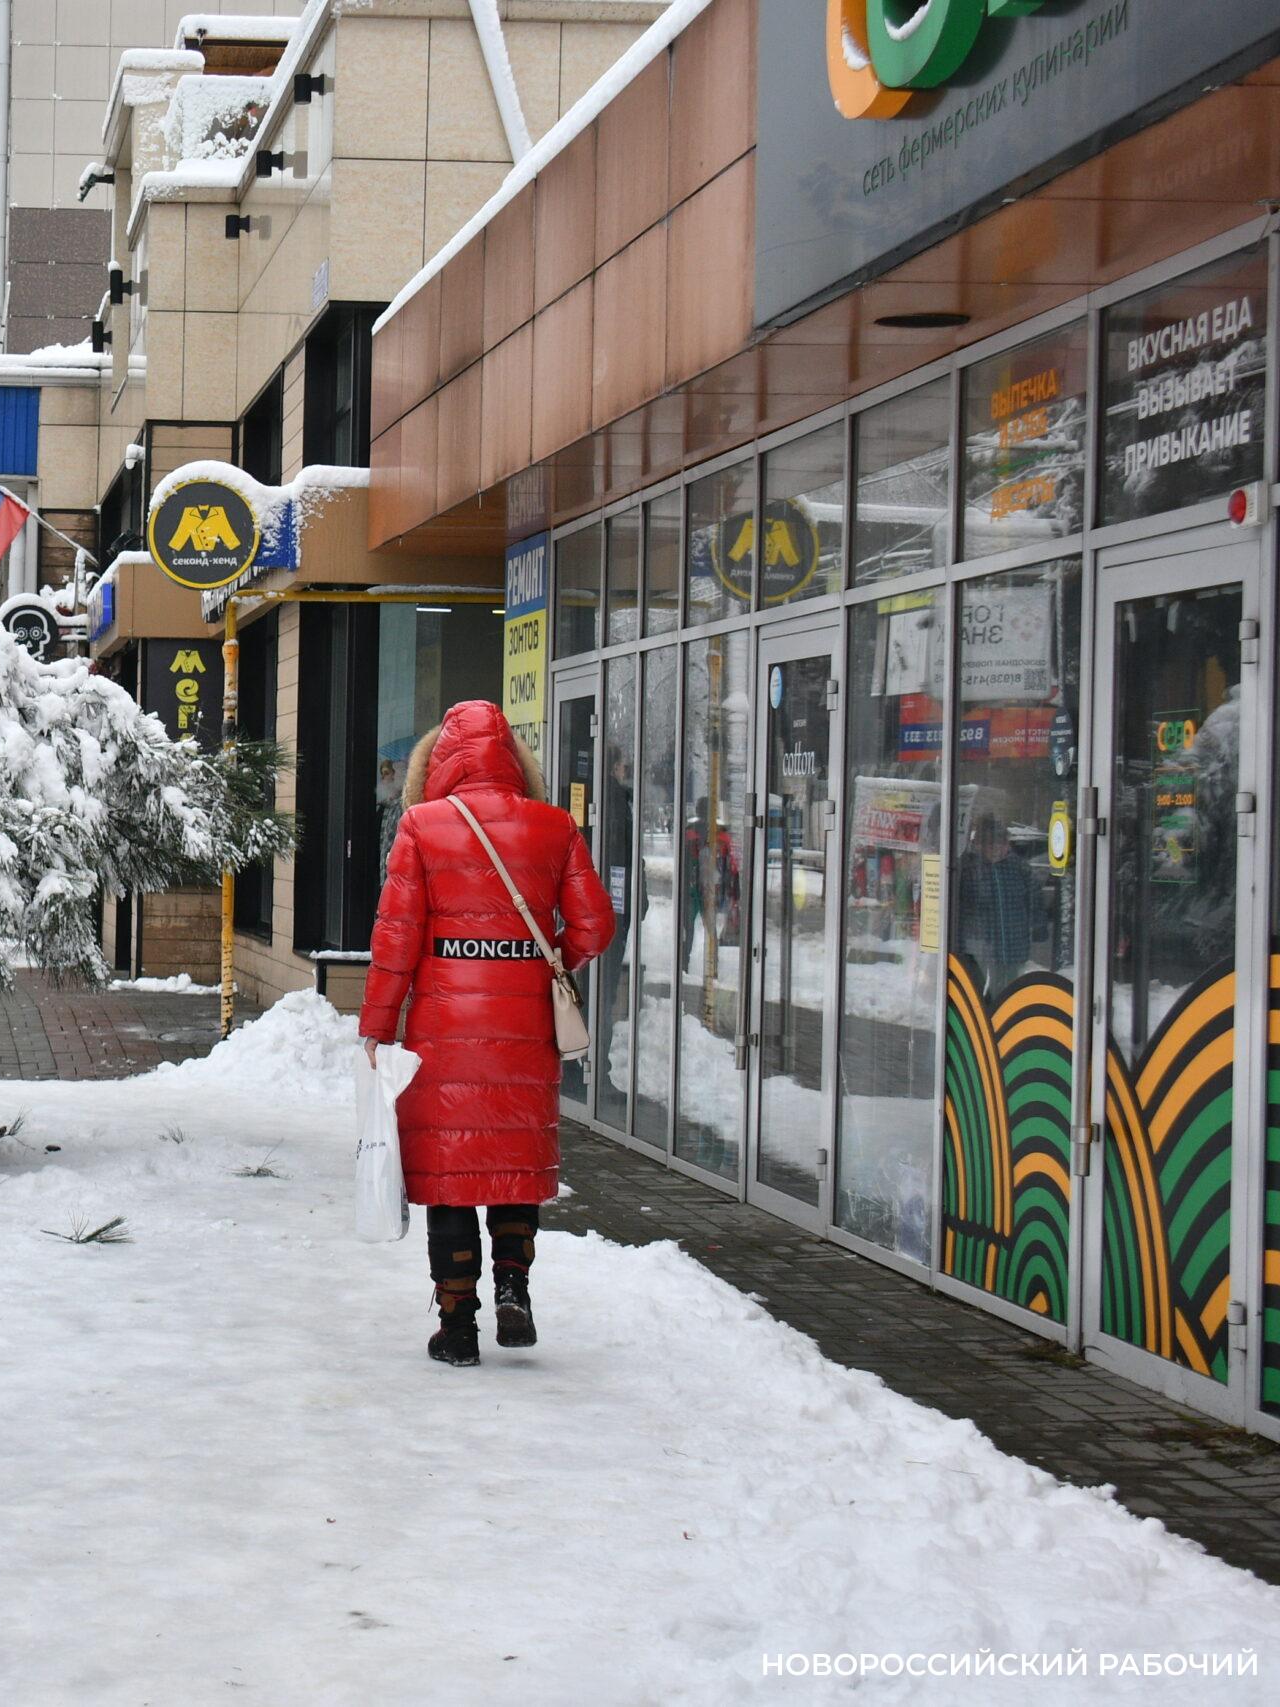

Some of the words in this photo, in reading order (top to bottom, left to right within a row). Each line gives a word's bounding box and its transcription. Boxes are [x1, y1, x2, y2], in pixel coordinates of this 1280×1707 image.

[862, 156, 895, 197] сеть
[898, 79, 1007, 181] фермерских
[1127, 311, 1209, 372] ВКУСНАЯ
[1212, 296, 1252, 344] ЕДА
[991, 368, 1058, 420] ВЫПЕЧКА
[1138, 357, 1238, 420] ВЫЗЫВАЕТ
[1124, 409, 1252, 476] ПРИВЫКАНИЕ
[172, 556, 238, 567] секонд-хенд
[506, 545, 545, 608] РЕМОНТ
[508, 619, 539, 656] ЗОНТОВ
[509, 670, 537, 705] СУМОК
[782, 741, 816, 776] cotton
[442, 939, 541, 958] MONCLER
